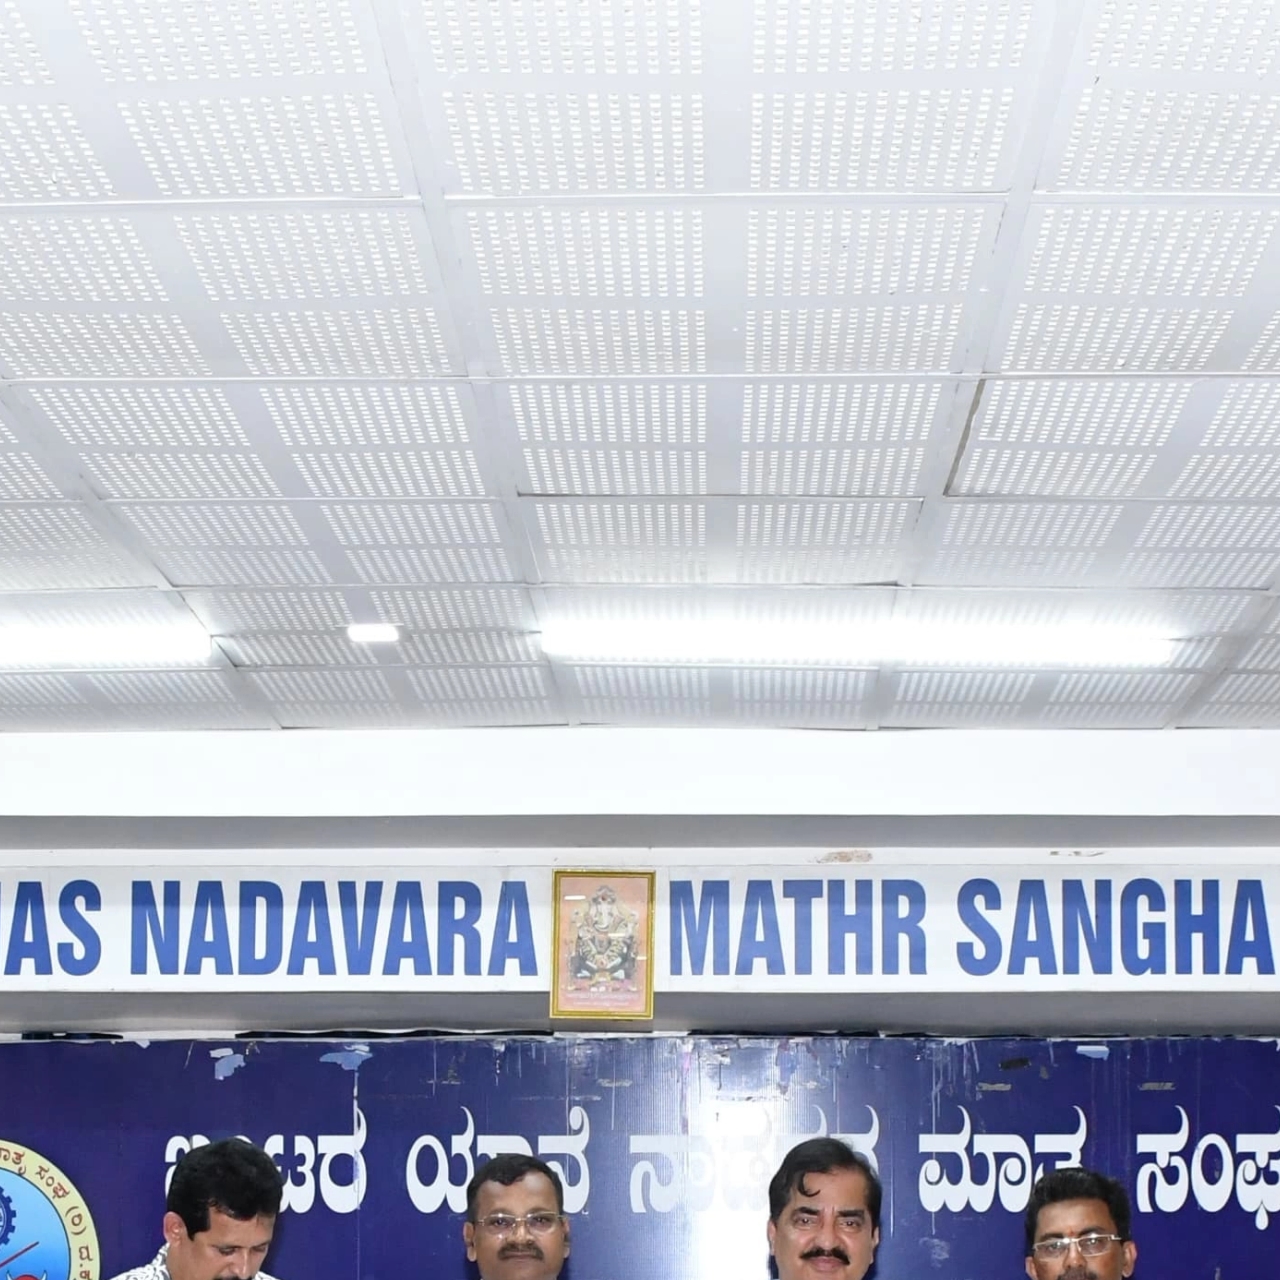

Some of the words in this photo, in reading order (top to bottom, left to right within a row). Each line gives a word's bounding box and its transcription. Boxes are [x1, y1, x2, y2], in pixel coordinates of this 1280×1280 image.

[131, 880, 536, 975] NADAVARA
[671, 879, 926, 974] MATHR
[957, 878, 1275, 975] SANGHA
